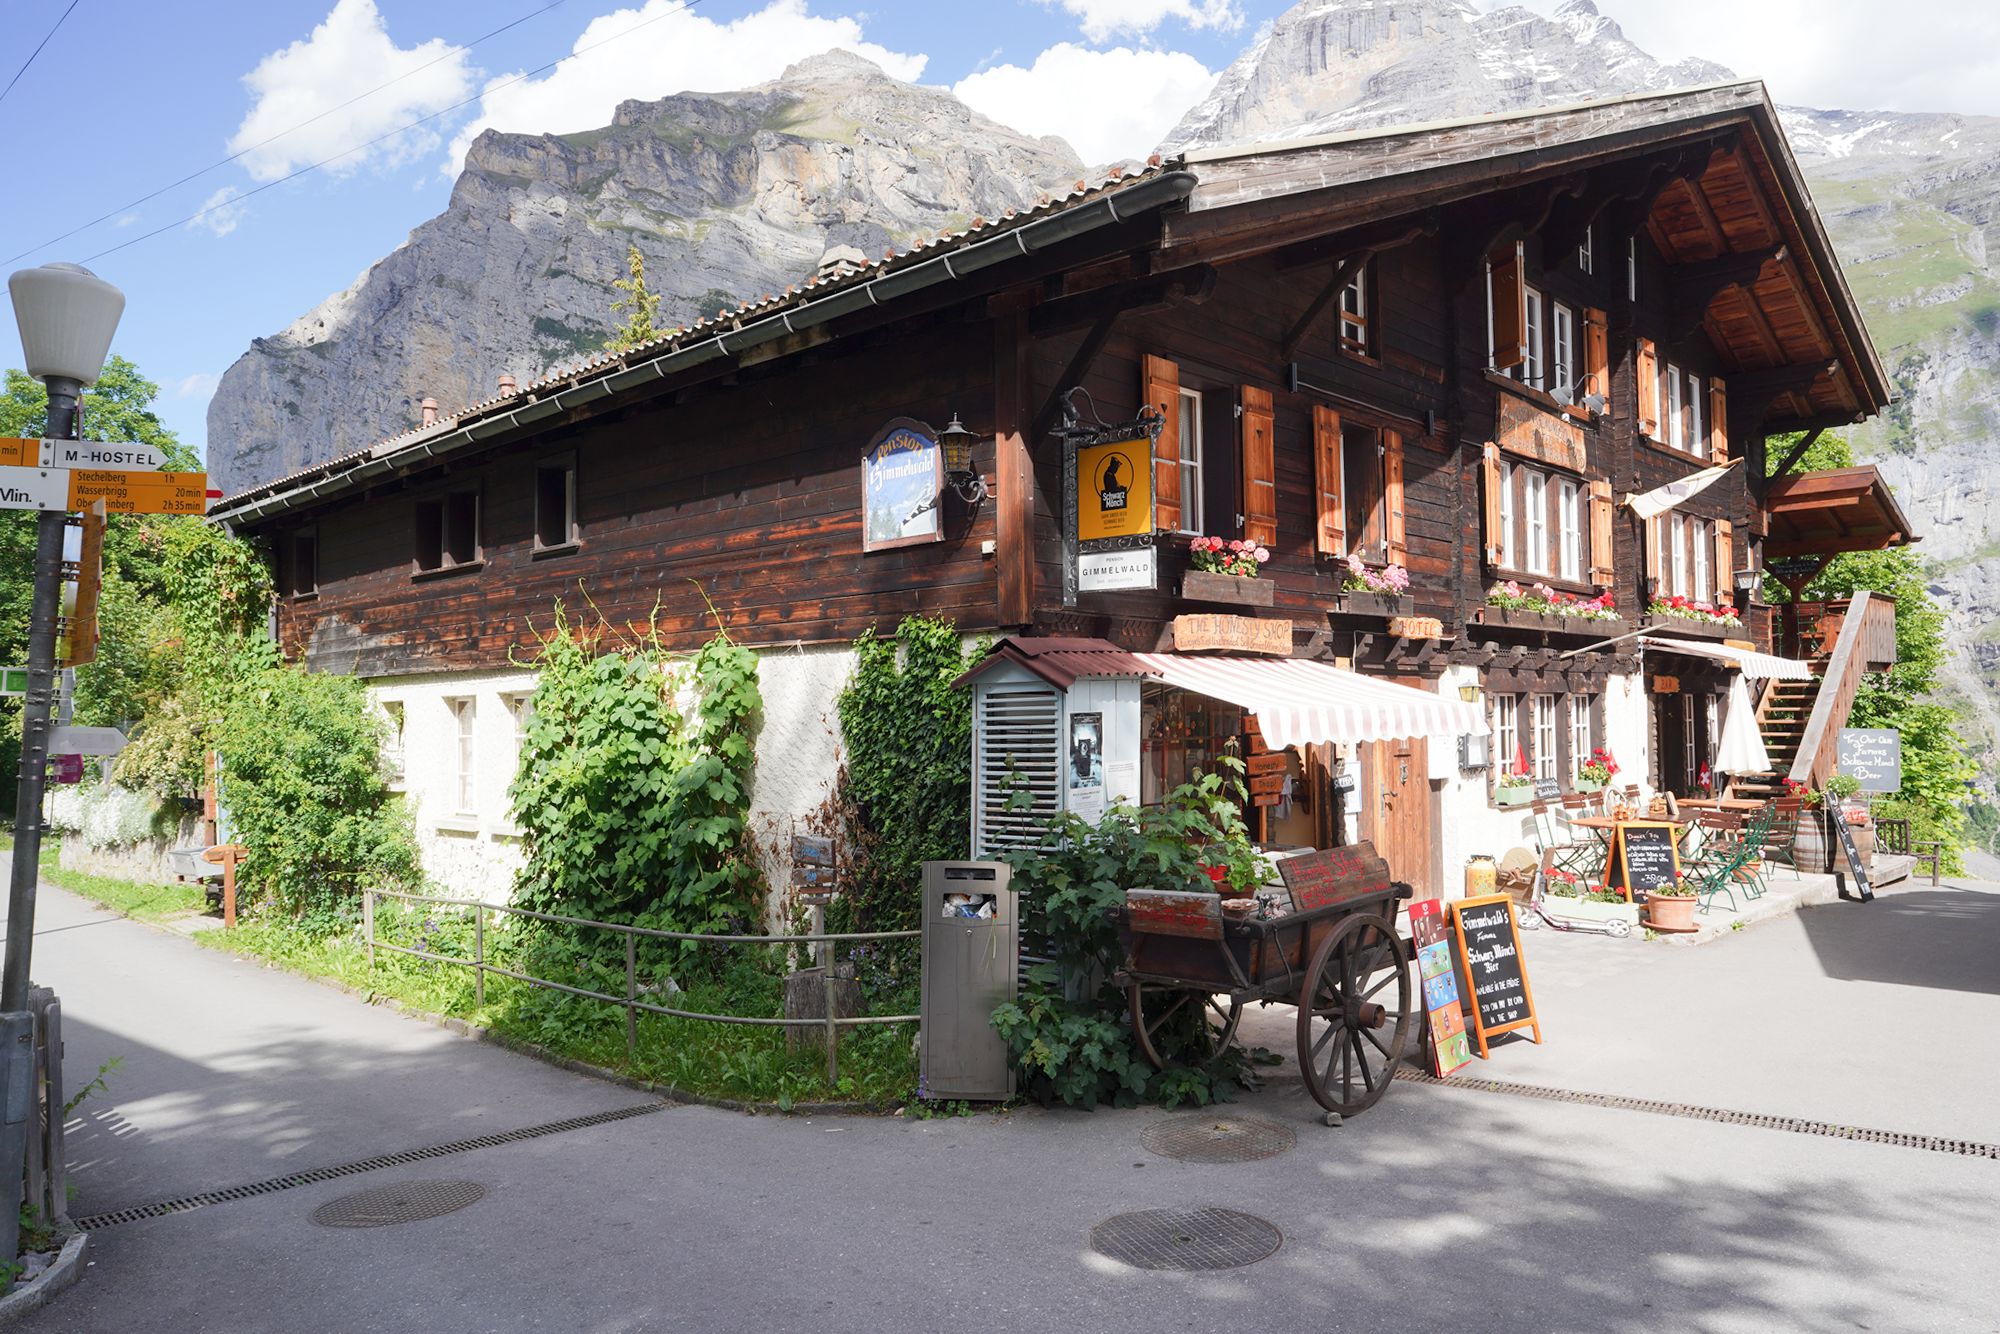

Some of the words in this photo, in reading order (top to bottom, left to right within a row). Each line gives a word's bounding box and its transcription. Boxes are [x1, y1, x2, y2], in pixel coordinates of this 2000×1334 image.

[1, 445, 18, 455] min
[877, 433, 924, 464] Pension
[77, 472, 126, 484] Stechelberg
[77, 486, 128, 498] Wasserbrigg
[1102, 491, 1126, 502] Schwarz
[1082, 563, 1149, 577] GIMMELWALD
[1187, 618, 1211, 634] THE
[1263, 621, 1290, 640] SHOP
[1399, 619, 1435, 636] HOTEL
[1483, 962, 1500, 974] Bier
